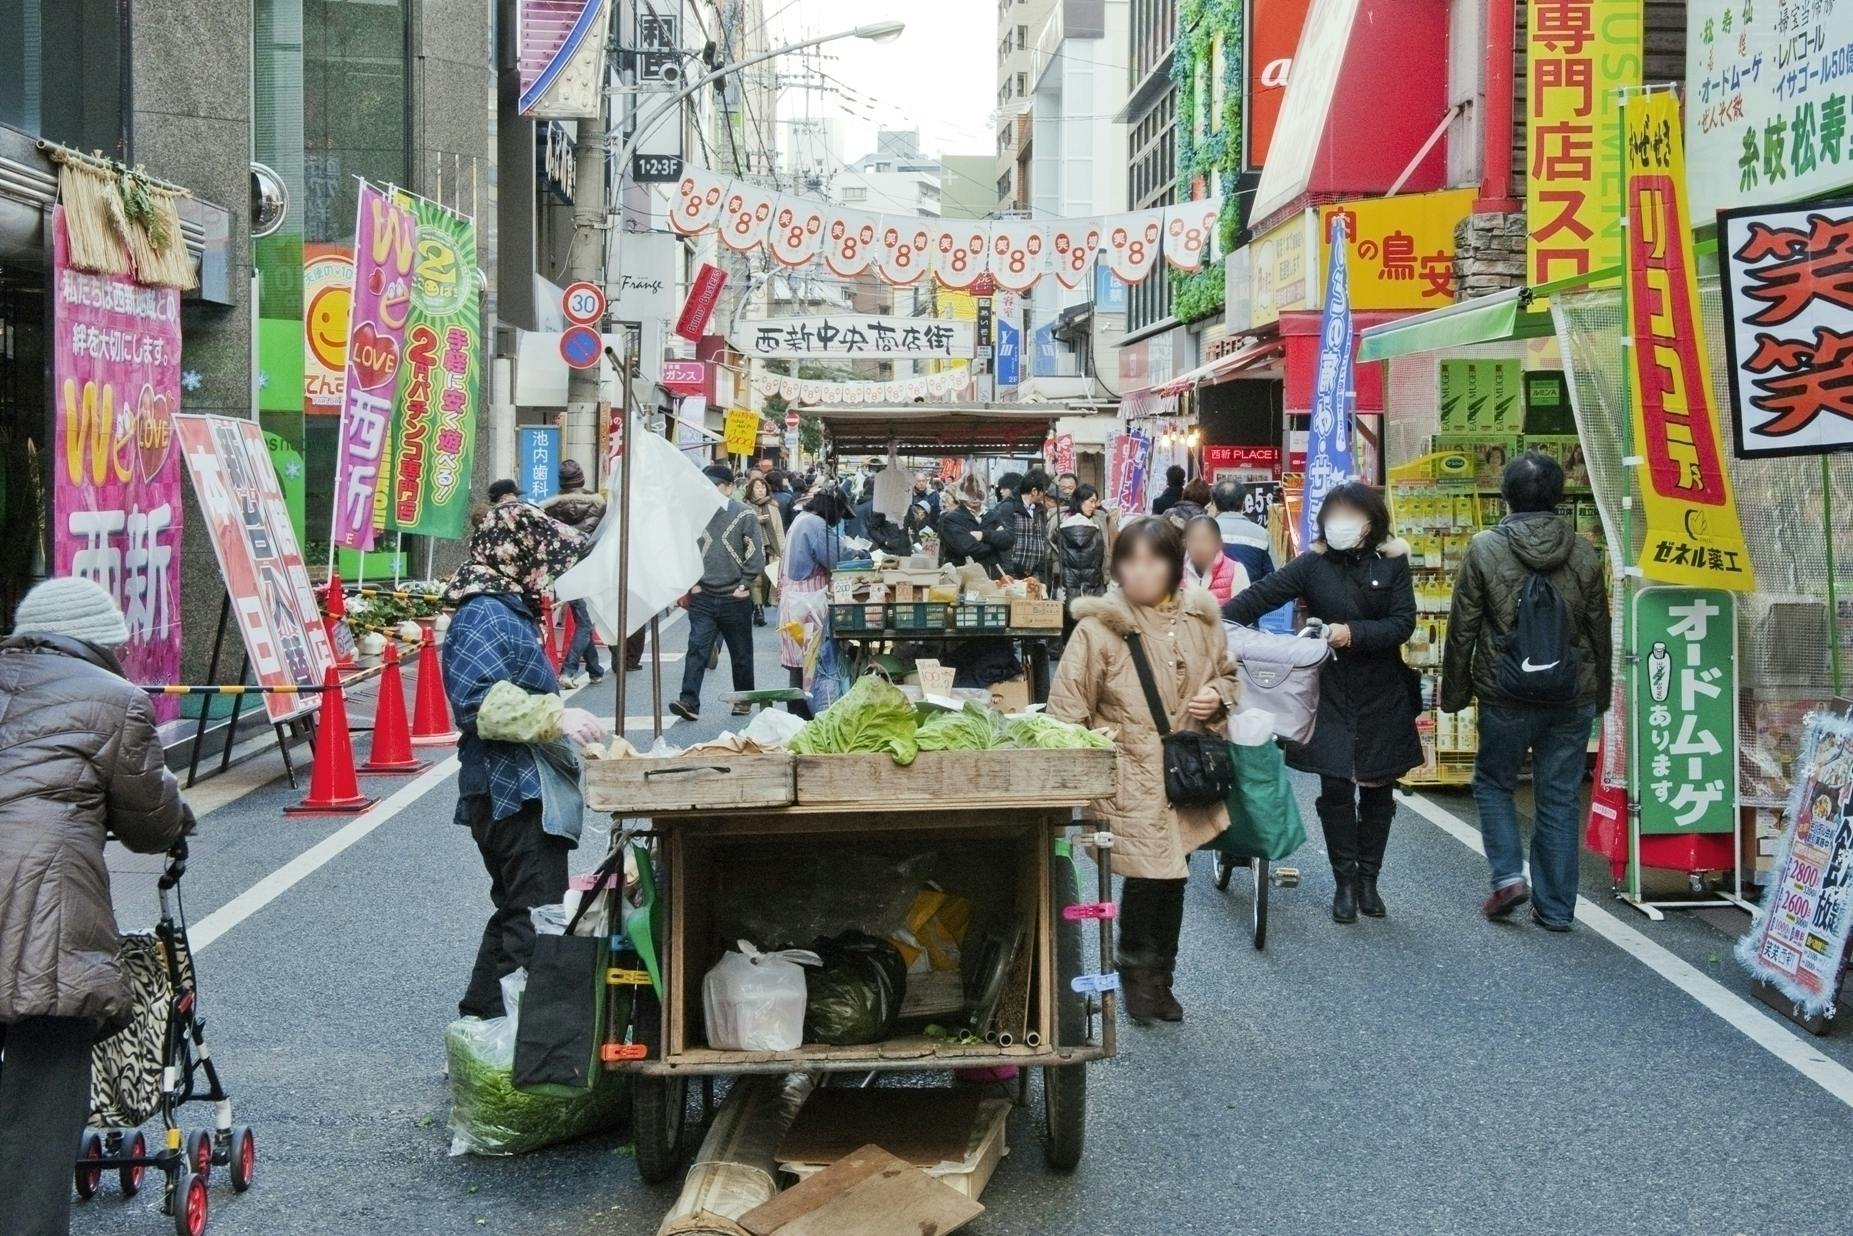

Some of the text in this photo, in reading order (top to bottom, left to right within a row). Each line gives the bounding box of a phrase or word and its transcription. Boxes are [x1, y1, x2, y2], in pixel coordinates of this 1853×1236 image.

[1738, 92, 1853, 193] 糸岐松寿
[686, 196, 701, 216] 8
[736, 212, 752, 234] 8
[787, 226, 803, 247] 8
[842, 237, 856, 259] 8
[1185, 228, 1201, 250] 8
[896, 245, 910, 267] 8
[952, 249, 966, 272] 8
[1009, 250, 1025, 273] 8
[1072, 247, 1085, 271] 8
[1129, 241, 1144, 264] 8
[621, 275, 664, 295] Frange
[572, 294, 596, 314] 30
[687, 268, 722, 336] Bunny Busters
[755, 318, 955, 356] 西新中央商店街
[353, 342, 396, 375] LOVE
[664, 371, 697, 380] ガンス
[532, 431, 549, 497] 池内歯科
[1211, 448, 1231, 459] 西新
[1654, 541, 1742, 573] ゼネル薬工
[1666, 599, 1725, 826] オードムーゲ
[1648, 703, 1673, 803] あります
[1790, 860, 1819, 888] 2800
[1781, 890, 1809, 918] 2600
